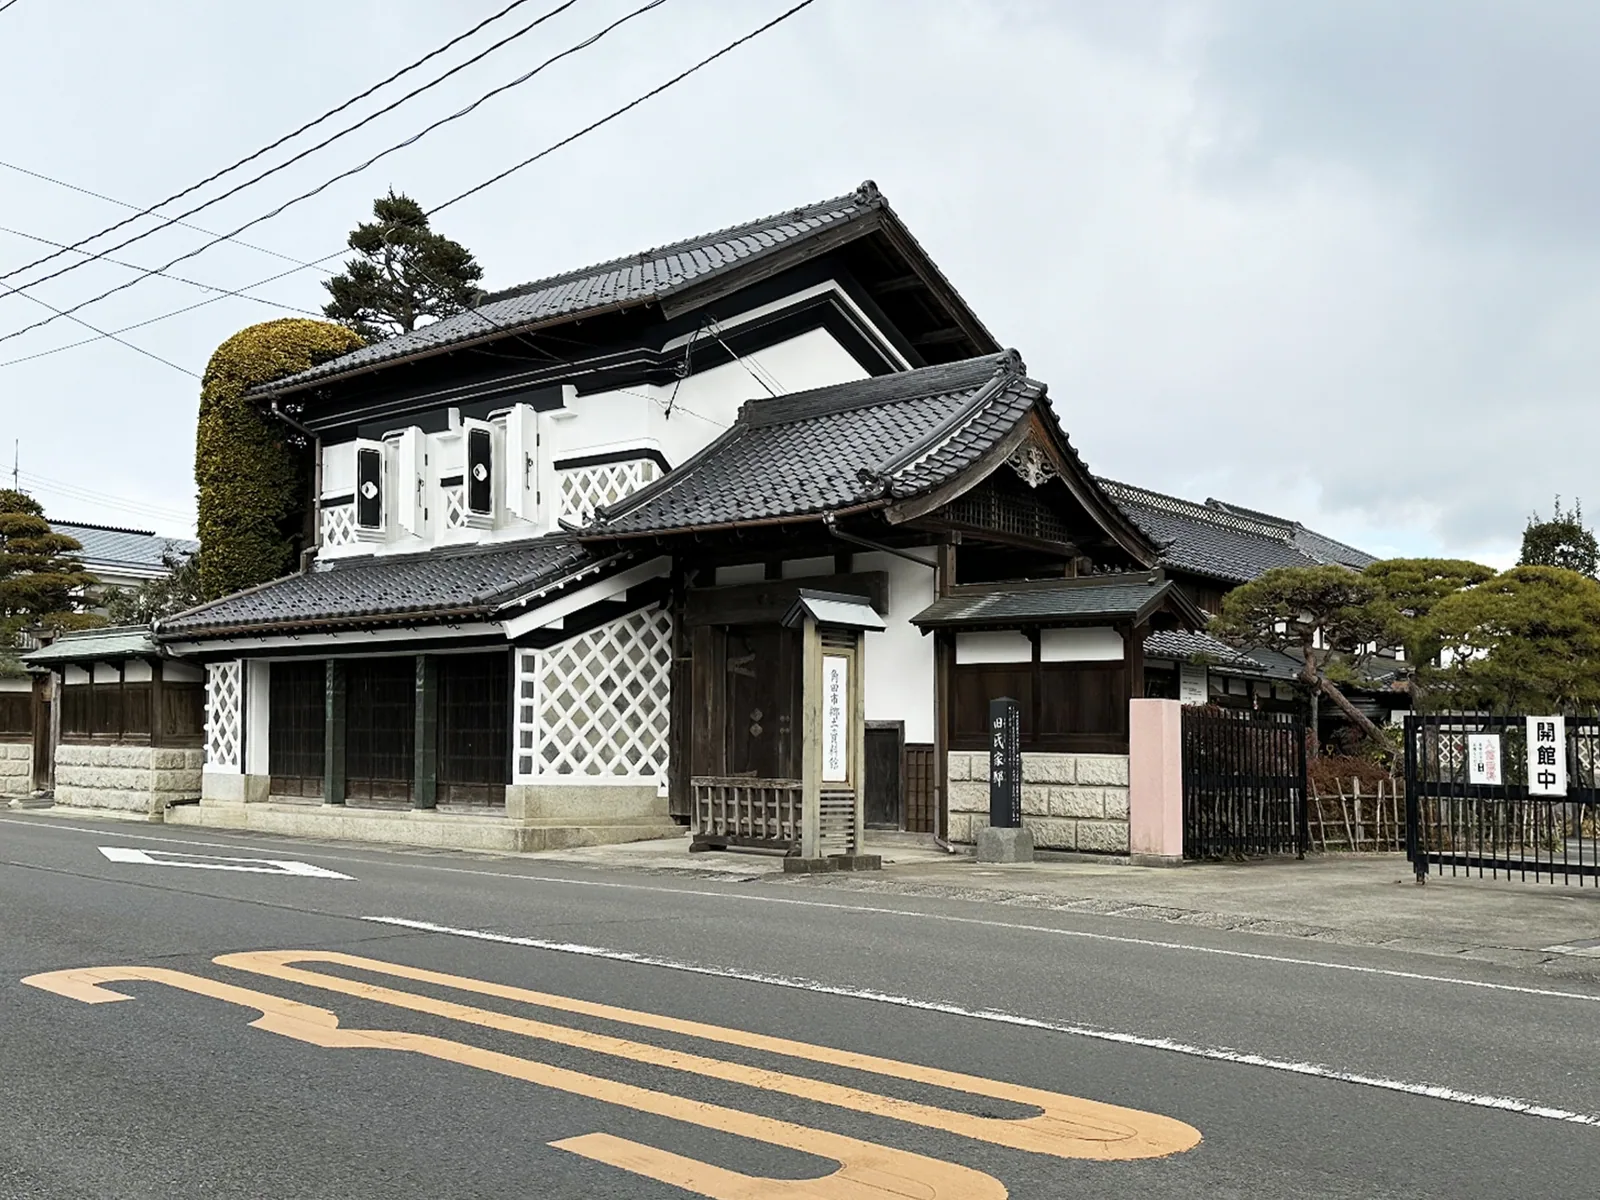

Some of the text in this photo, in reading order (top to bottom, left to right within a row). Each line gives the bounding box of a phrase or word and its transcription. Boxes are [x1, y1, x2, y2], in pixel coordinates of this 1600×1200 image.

[993, 718, 1004, 788] 旧氏家邸
[1537, 722, 1556, 790] 開館中
